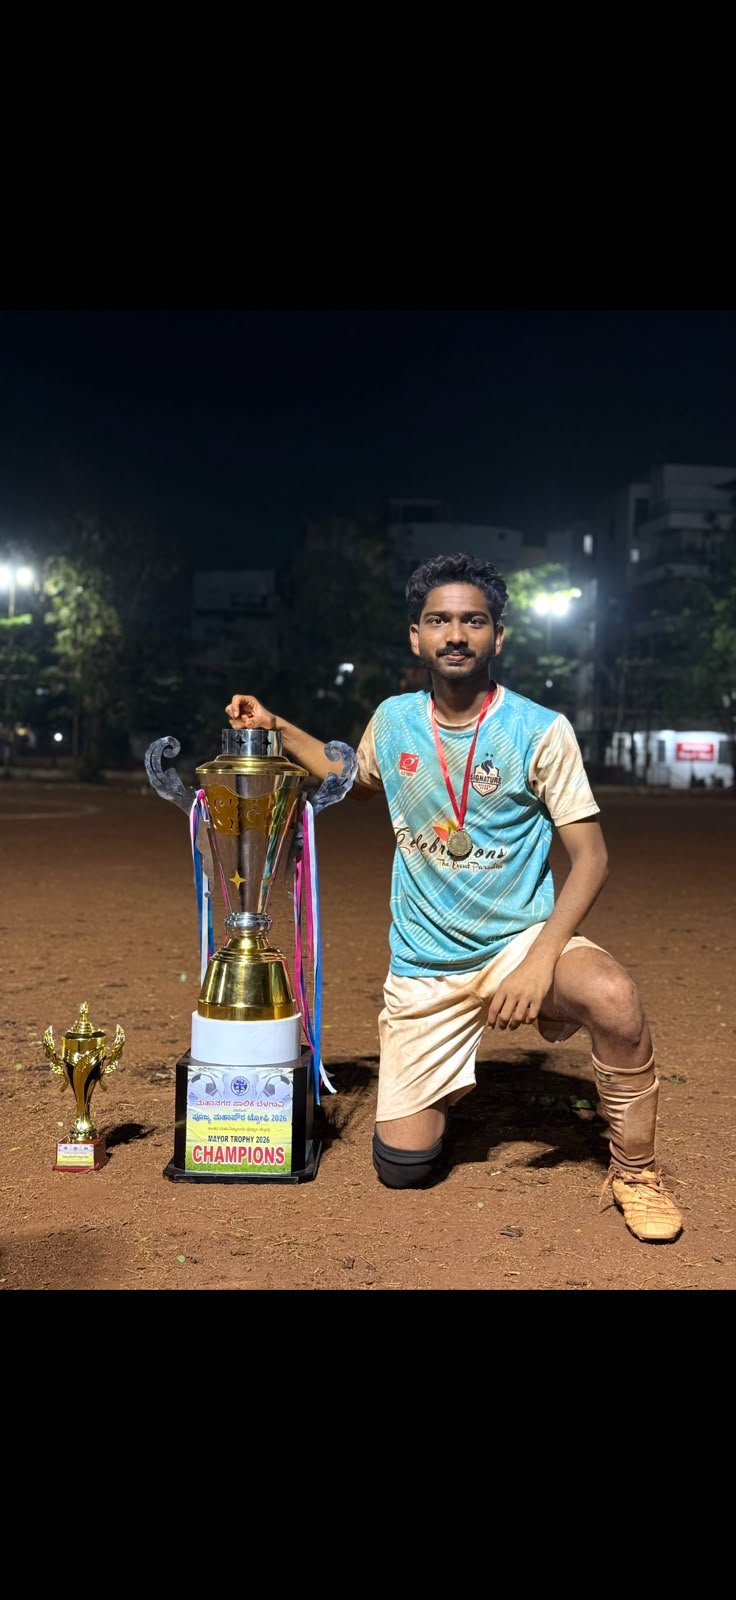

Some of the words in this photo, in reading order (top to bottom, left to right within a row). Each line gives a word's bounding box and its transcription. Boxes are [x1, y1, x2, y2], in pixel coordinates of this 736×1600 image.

[470, 774, 502, 785] SIGNATURE
[394, 826, 507, 859] Celebrons
[436, 858, 449, 867] The
[271, 1114, 287, 1122] 2026
[192, 1145, 285, 1164] CHAMPIONS
